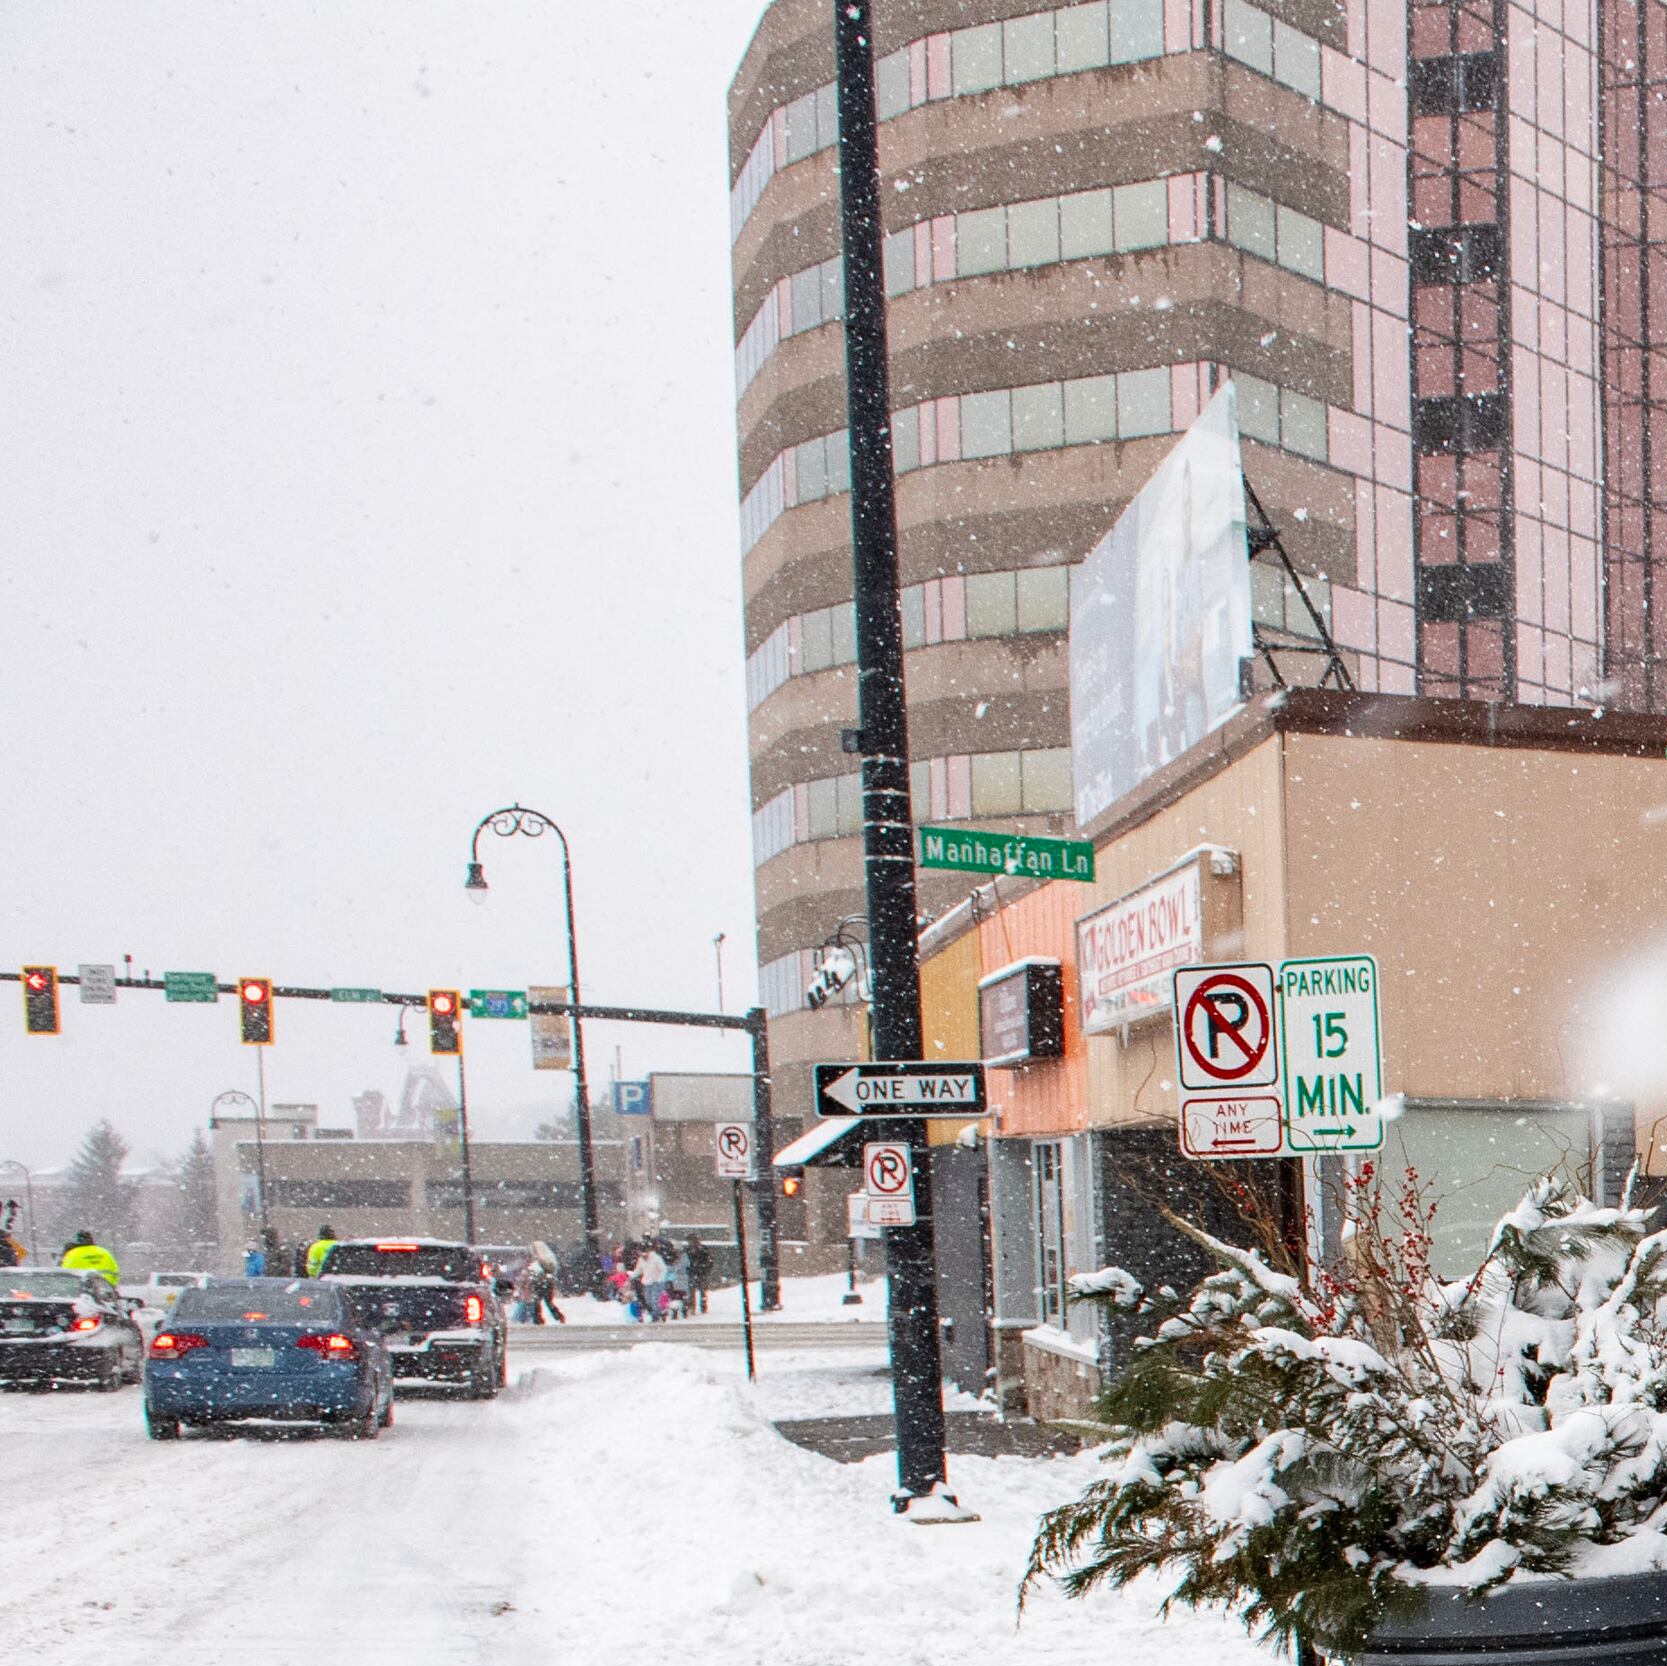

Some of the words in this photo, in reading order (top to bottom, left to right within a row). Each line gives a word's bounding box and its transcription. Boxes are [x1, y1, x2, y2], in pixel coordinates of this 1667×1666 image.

[925, 835, 1052, 872] Manhattan
[1062, 848, 1088, 873] Ln
[1098, 910, 1145, 973] GOLDEN
[1149, 885, 1191, 950] BOWL
[1287, 967, 1370, 998] PARKING
[1313, 1012, 1349, 1059] 15
[620, 1085, 643, 1111] P
[856, 1080, 905, 1101] ONE
[919, 1078, 969, 1099] WAY
[1297, 1073, 1371, 1118] MIN.
[1216, 1103, 1249, 1118] ANY
[1214, 1120, 1252, 1136] TIME
